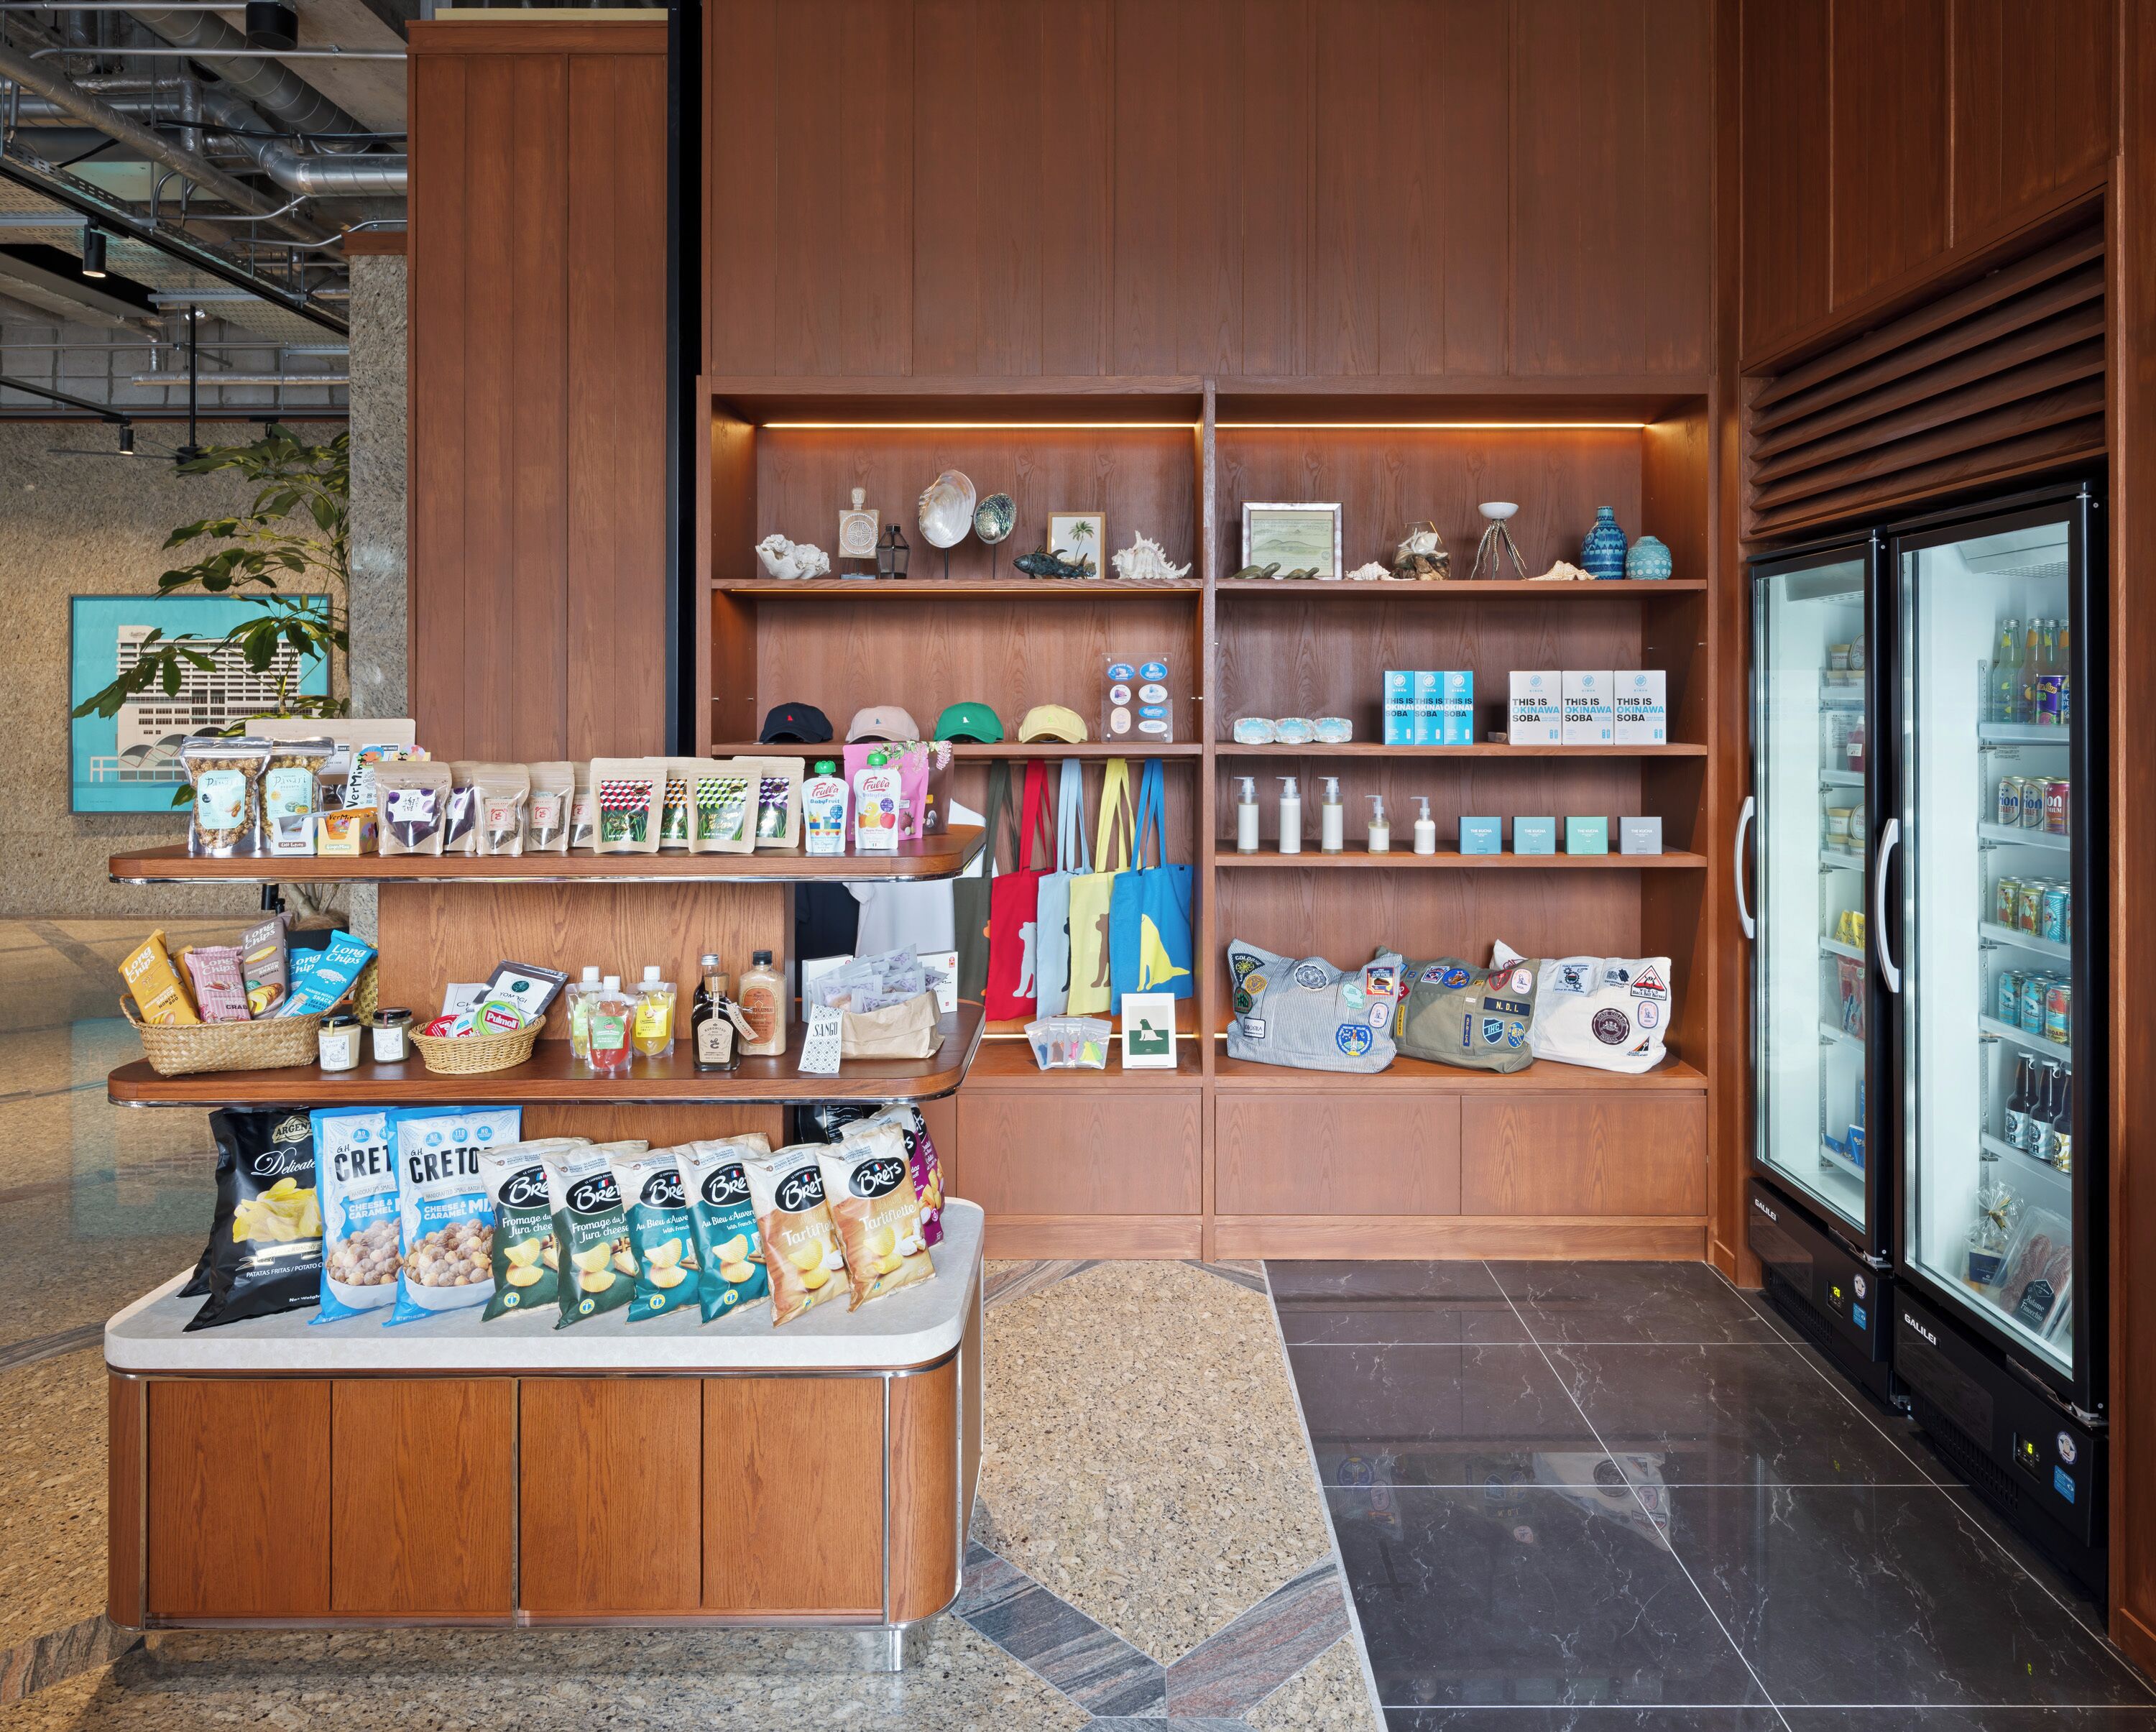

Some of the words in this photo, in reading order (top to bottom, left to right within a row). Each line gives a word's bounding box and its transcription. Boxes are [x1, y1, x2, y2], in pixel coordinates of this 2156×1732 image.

[346, 753, 367, 808] VerMints
[244, 929, 276, 950] Chips
[245, 922, 275, 944] Long
[326, 953, 361, 964] Chips
[331, 944, 367, 958] Long
[125, 946, 152, 977] Long
[129, 954, 155, 984] Chips
[201, 957, 234, 969] Long
[202, 964, 236, 975] Chips
[259, 964, 280, 975] SNACK
[312, 995, 332, 1005] SNACK
[487, 1011, 517, 1029] Pulmoll
[1596, 1011, 1609, 1021] STATE
[1611, 1012, 1626, 1027] COLLEGE
[812, 1021, 838, 1037] SANGO
[1488, 1023, 1500, 1034] IHC
[251, 1148, 315, 1176] Delicate
[409, 1146, 493, 1184] CRETO
[857, 1162, 902, 1195] Brets
[349, 1200, 385, 1212] CHEESE
[349, 1206, 394, 1220] CARAMEL
[424, 1202, 459, 1213] CHEESE
[1755, 1199, 1777, 1221] GALILEI
[424, 1209, 467, 1220] CARAMEL
[502, 1215, 542, 1228] Fromage
[859, 1204, 917, 1232] Tartiflette
[571, 1219, 612, 1234] Fromage
[646, 1219, 665, 1228] Bleu
[701, 1220, 711, 1229] Au
[711, 1216, 728, 1225] Bleu
[508, 1226, 531, 1238] Jura
[533, 1223, 553, 1232] chee
[579, 1231, 602, 1243] Jura
[603, 1225, 630, 1236] cheese
[246, 1269, 270, 1278] PATATAS
[271, 1266, 290, 1275] FRITAS
[2025, 1295, 2045, 1312] Salame
[2020, 1302, 2043, 1322] Finocchio
[1904, 1313, 1936, 1345] GALILEI
